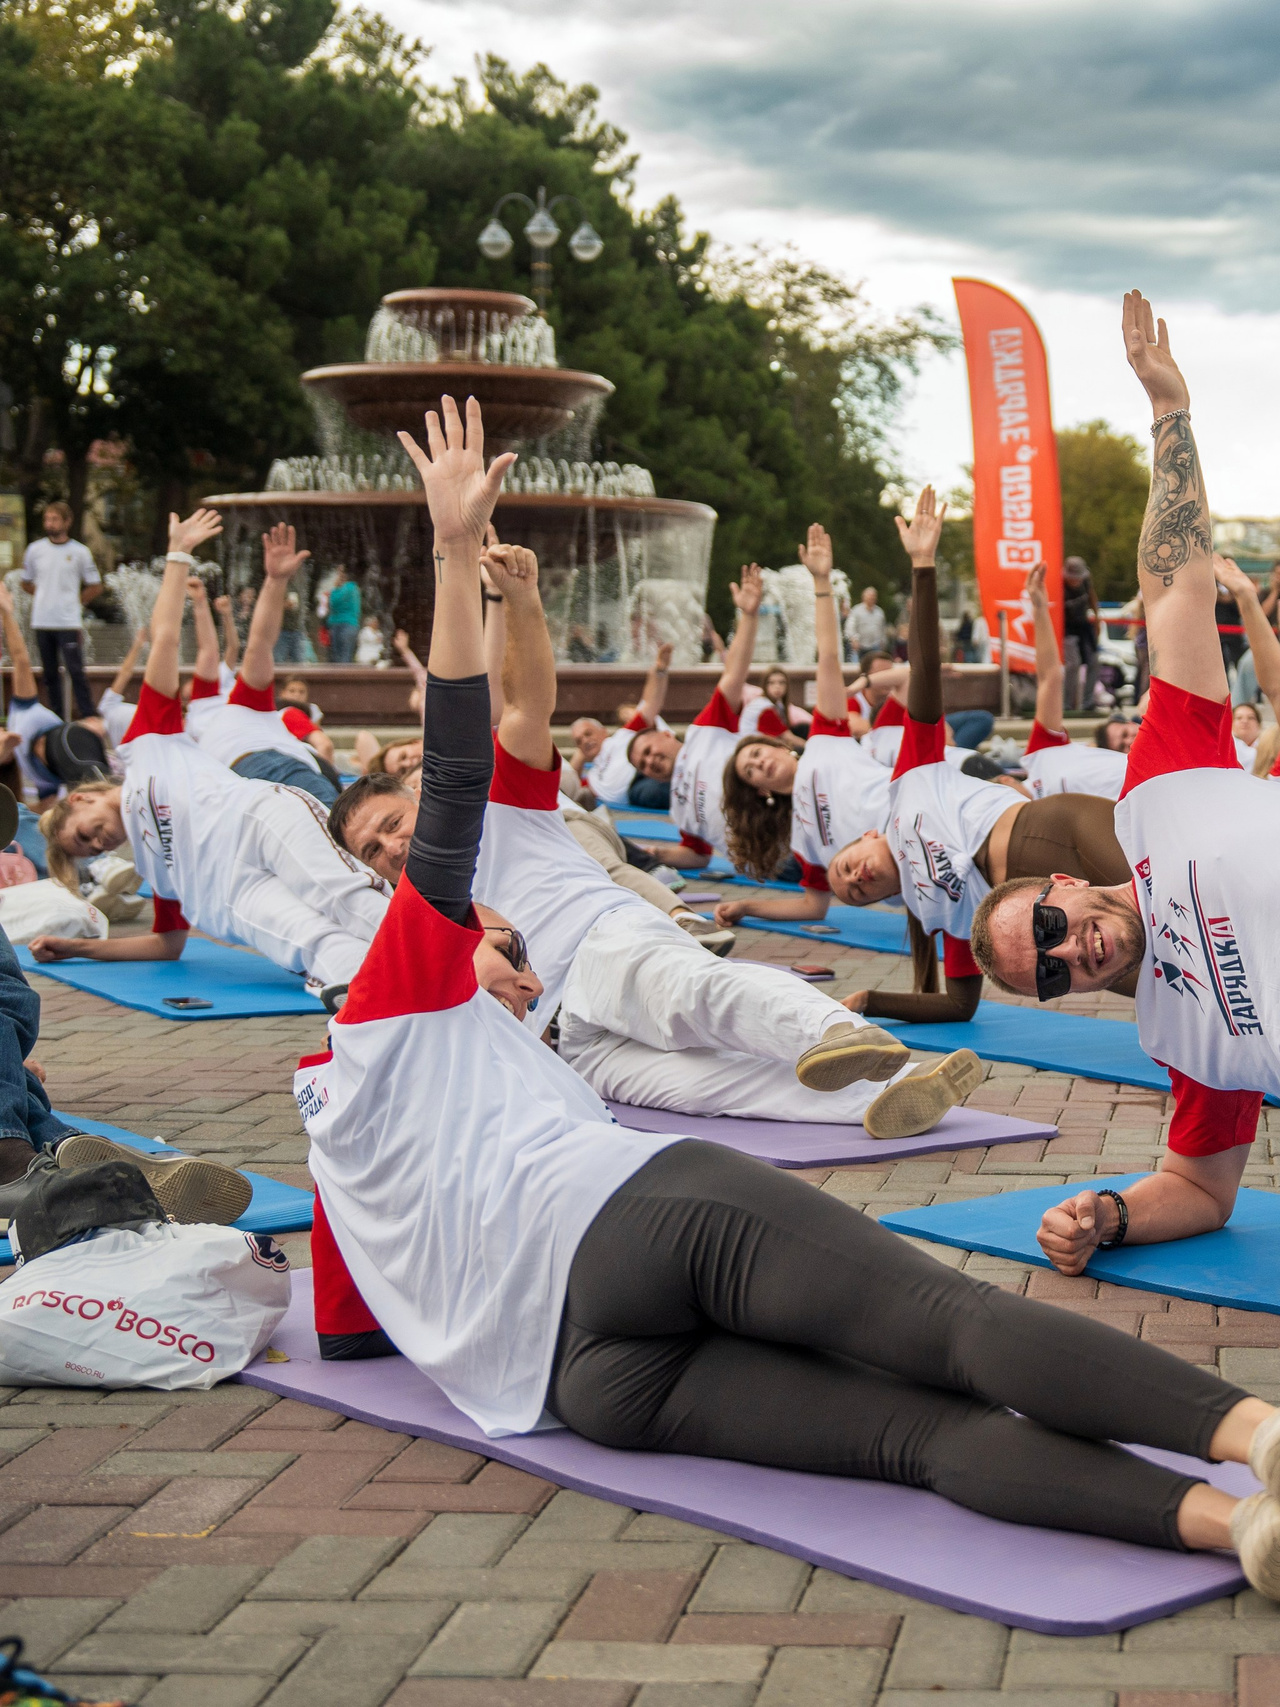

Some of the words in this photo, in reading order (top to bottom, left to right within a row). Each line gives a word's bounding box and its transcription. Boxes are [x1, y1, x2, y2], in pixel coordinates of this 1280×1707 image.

[1207, 916, 1264, 1036] ЗАРЯДКА
[297, 1083, 315, 1110] SCO
[114, 1307, 216, 1363] BOSCO
[65, 1361, 105, 1380] BOSCO.RU
